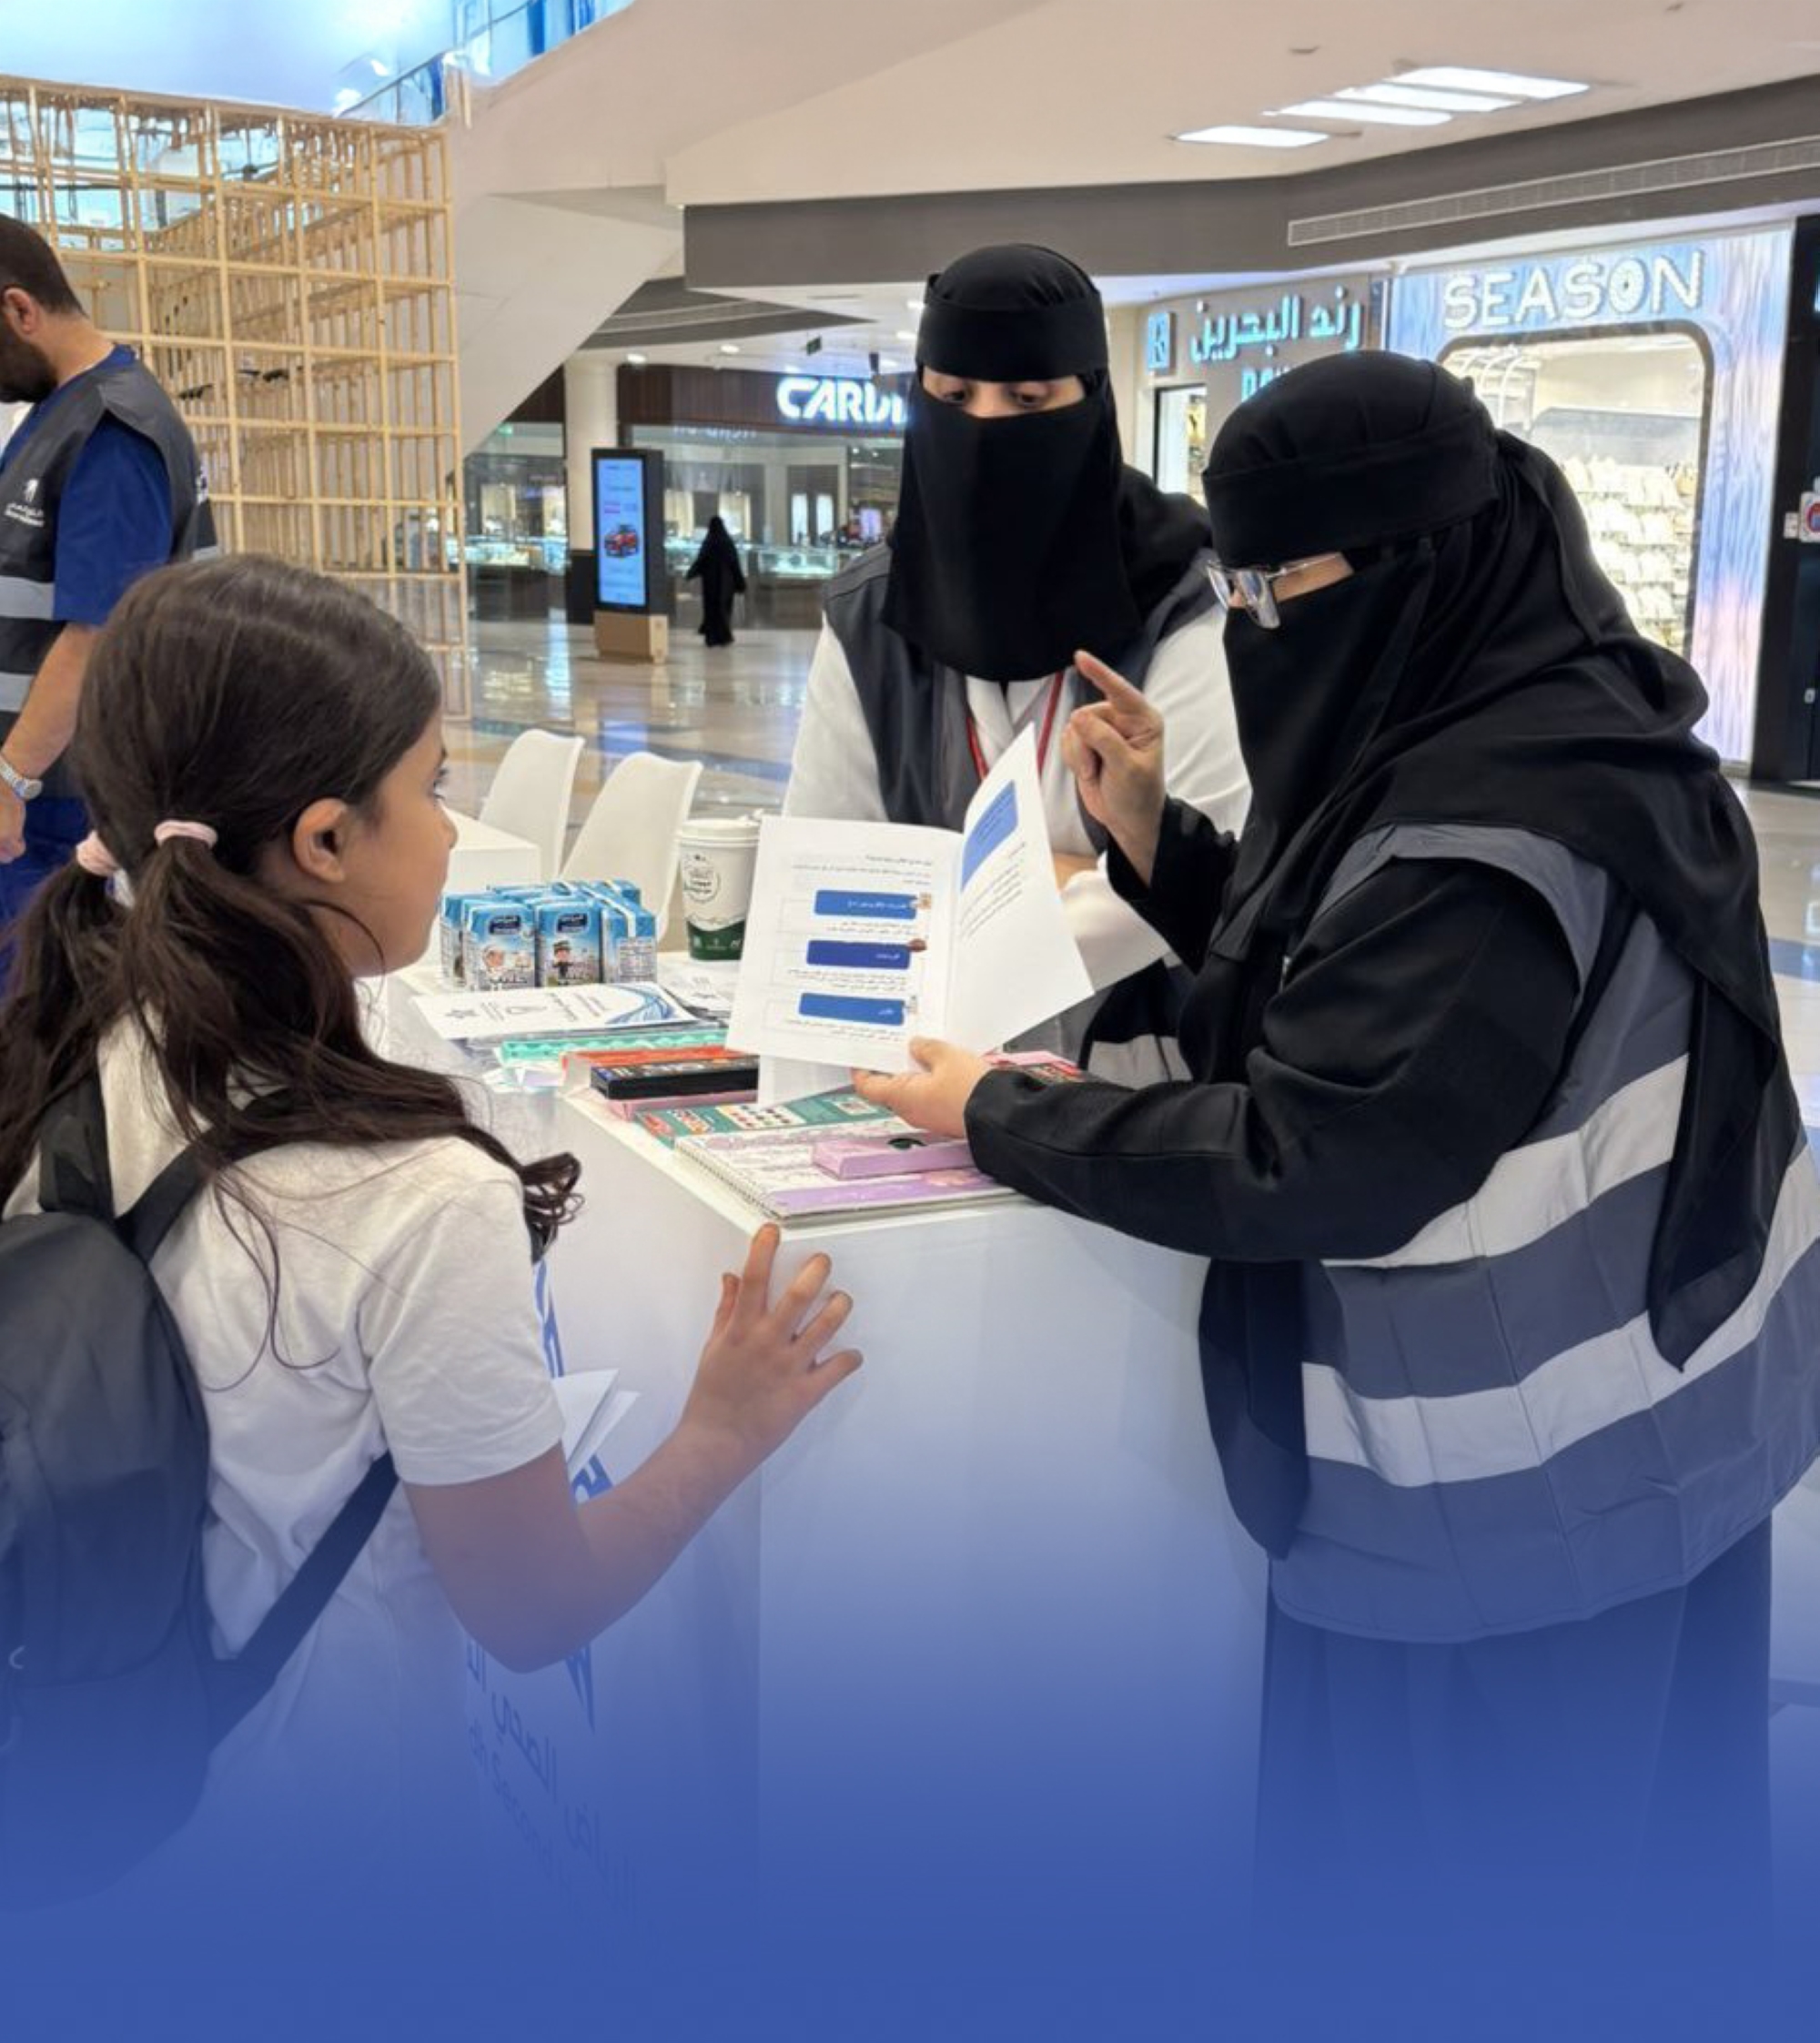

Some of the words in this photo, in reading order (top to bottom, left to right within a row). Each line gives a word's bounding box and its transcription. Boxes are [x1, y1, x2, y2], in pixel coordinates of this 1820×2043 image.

[1309, 286, 1362, 350] رند
[1443, 250, 1704, 329] SEASON
[1190, 294, 1302, 362] البحرين
[777, 376, 908, 424] CARDI
